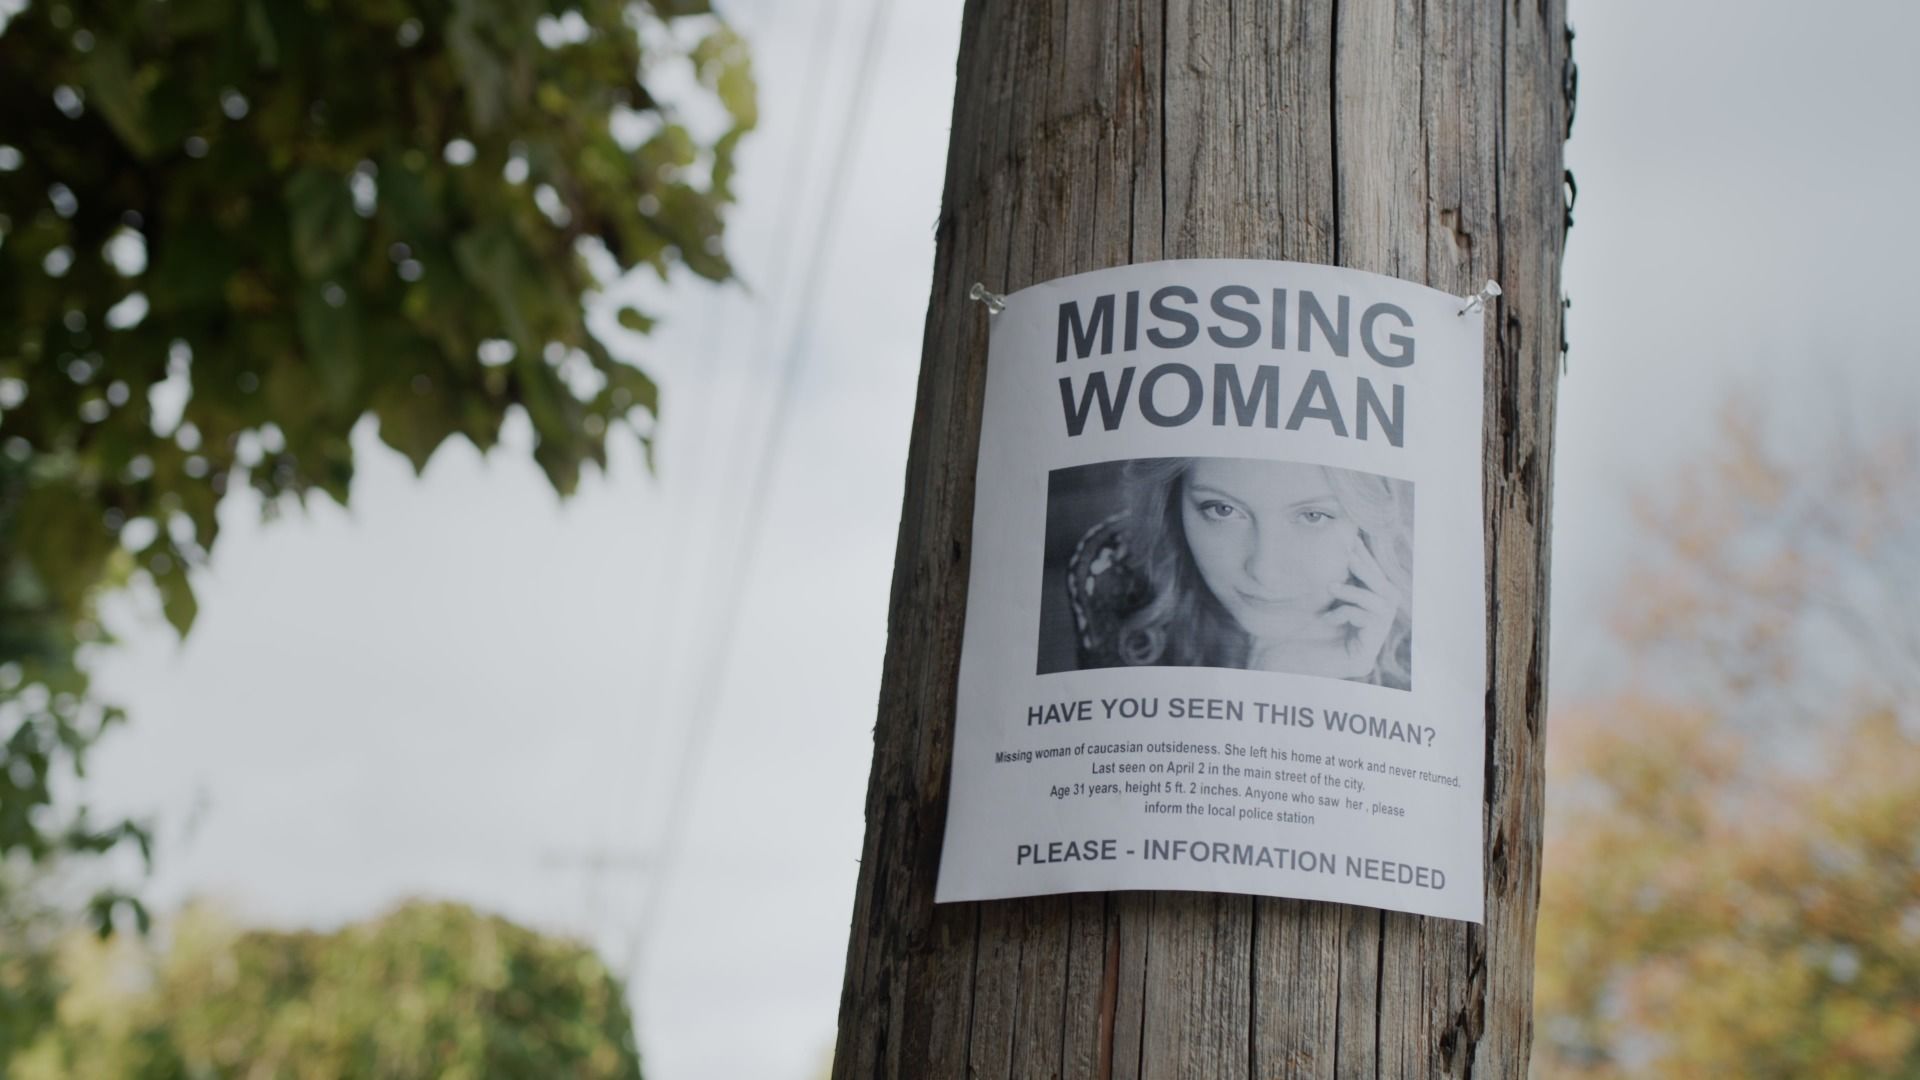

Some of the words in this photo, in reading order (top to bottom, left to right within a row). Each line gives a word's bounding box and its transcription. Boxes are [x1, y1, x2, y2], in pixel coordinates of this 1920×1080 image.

[1056, 285, 1416, 369] MISSING
[1058, 363, 1405, 448] WOMAN
[1027, 699, 1092, 726] HAVE
[1101, 698, 1158, 719] YOU
[1168, 698, 1243, 721] SEEN
[1254, 702, 1314, 728] THIS
[1323, 710, 1436, 747] WOMAN?
[995, 751, 1032, 763] Missing
[1035, 747, 1071, 759] woman
[1074, 743, 1085, 755] of
[1088, 742, 1143, 754] caucasian
[1147, 741, 1221, 754] outsideness.
[1224, 744, 1246, 757] She
[1250, 746, 1268, 759] left
[1271, 748, 1288, 761] his
[1291, 750, 1322, 764] home
[1325, 755, 1335, 766] at
[1338, 758, 1364, 770] work
[1367, 762, 1386, 774] and
[1389, 766, 1416, 778] never
[1420, 771, 1461, 788] returned.
[1092, 762, 1115, 774] Last
[1119, 764, 1145, 773] seen
[1149, 764, 1163, 773] on
[1167, 761, 1194, 776] April
[1198, 762, 1205, 774] 2
[1208, 763, 1218, 775] in
[1223, 764, 1240, 776] the
[1244, 768, 1271, 779] main
[1275, 771, 1306, 783] street
[1311, 773, 1321, 784] of
[1324, 775, 1341, 787] the
[1344, 778, 1365, 792] city.
[1050, 785, 1070, 799] Age
[1073, 784, 1085, 795] 31
[1089, 784, 1122, 797] years,
[1125, 781, 1161, 796] height
[1165, 781, 1172, 793] 5
[1175, 781, 1186, 793] ft.
[1190, 782, 1197, 794] 2
[1200, 783, 1242, 797] inches.
[1245, 786, 1288, 802] Anyone
[1292, 792, 1315, 804] who
[1319, 797, 1340, 807] saw
[1373, 803, 1405, 817] please
[1144, 801, 1182, 814] inform
[1186, 803, 1204, 815] the
[1208, 804, 1235, 817] local
[1239, 808, 1273, 820] police
[1277, 812, 1315, 825] station
[1017, 840, 1117, 865] PLEASE
[1144, 839, 1336, 874] INFORMATION
[1346, 856, 1445, 890] NEEDED
